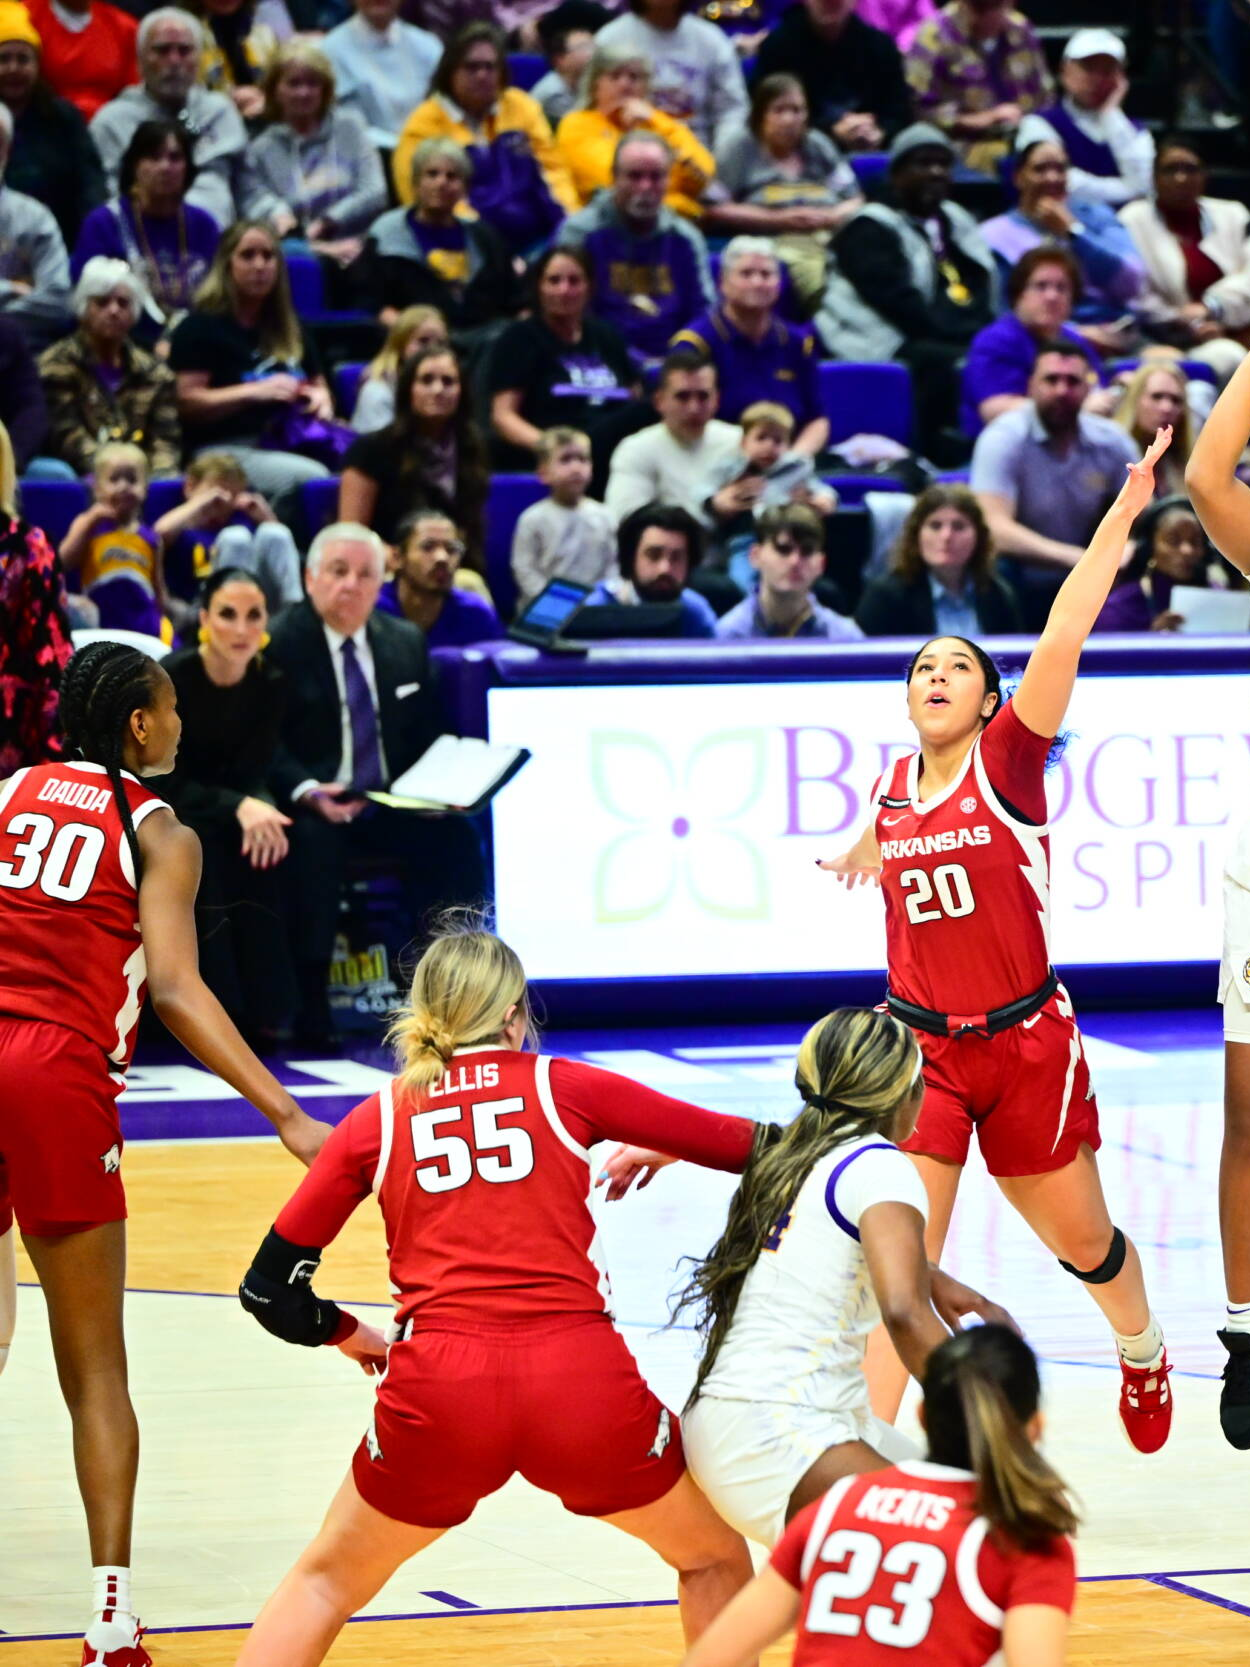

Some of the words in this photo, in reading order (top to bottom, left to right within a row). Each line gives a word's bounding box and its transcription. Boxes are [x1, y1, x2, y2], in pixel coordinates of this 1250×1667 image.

[37, 778, 113, 814] DAUDA
[0, 812, 106, 902] 30
[880, 825, 992, 861] ARKANSAS
[899, 862, 976, 925] 20
[428, 1063, 499, 1098] ELLIS
[410, 1096, 535, 1194] 55
[855, 1485, 957, 1531] KEATS
[805, 1529, 947, 1648] 23
